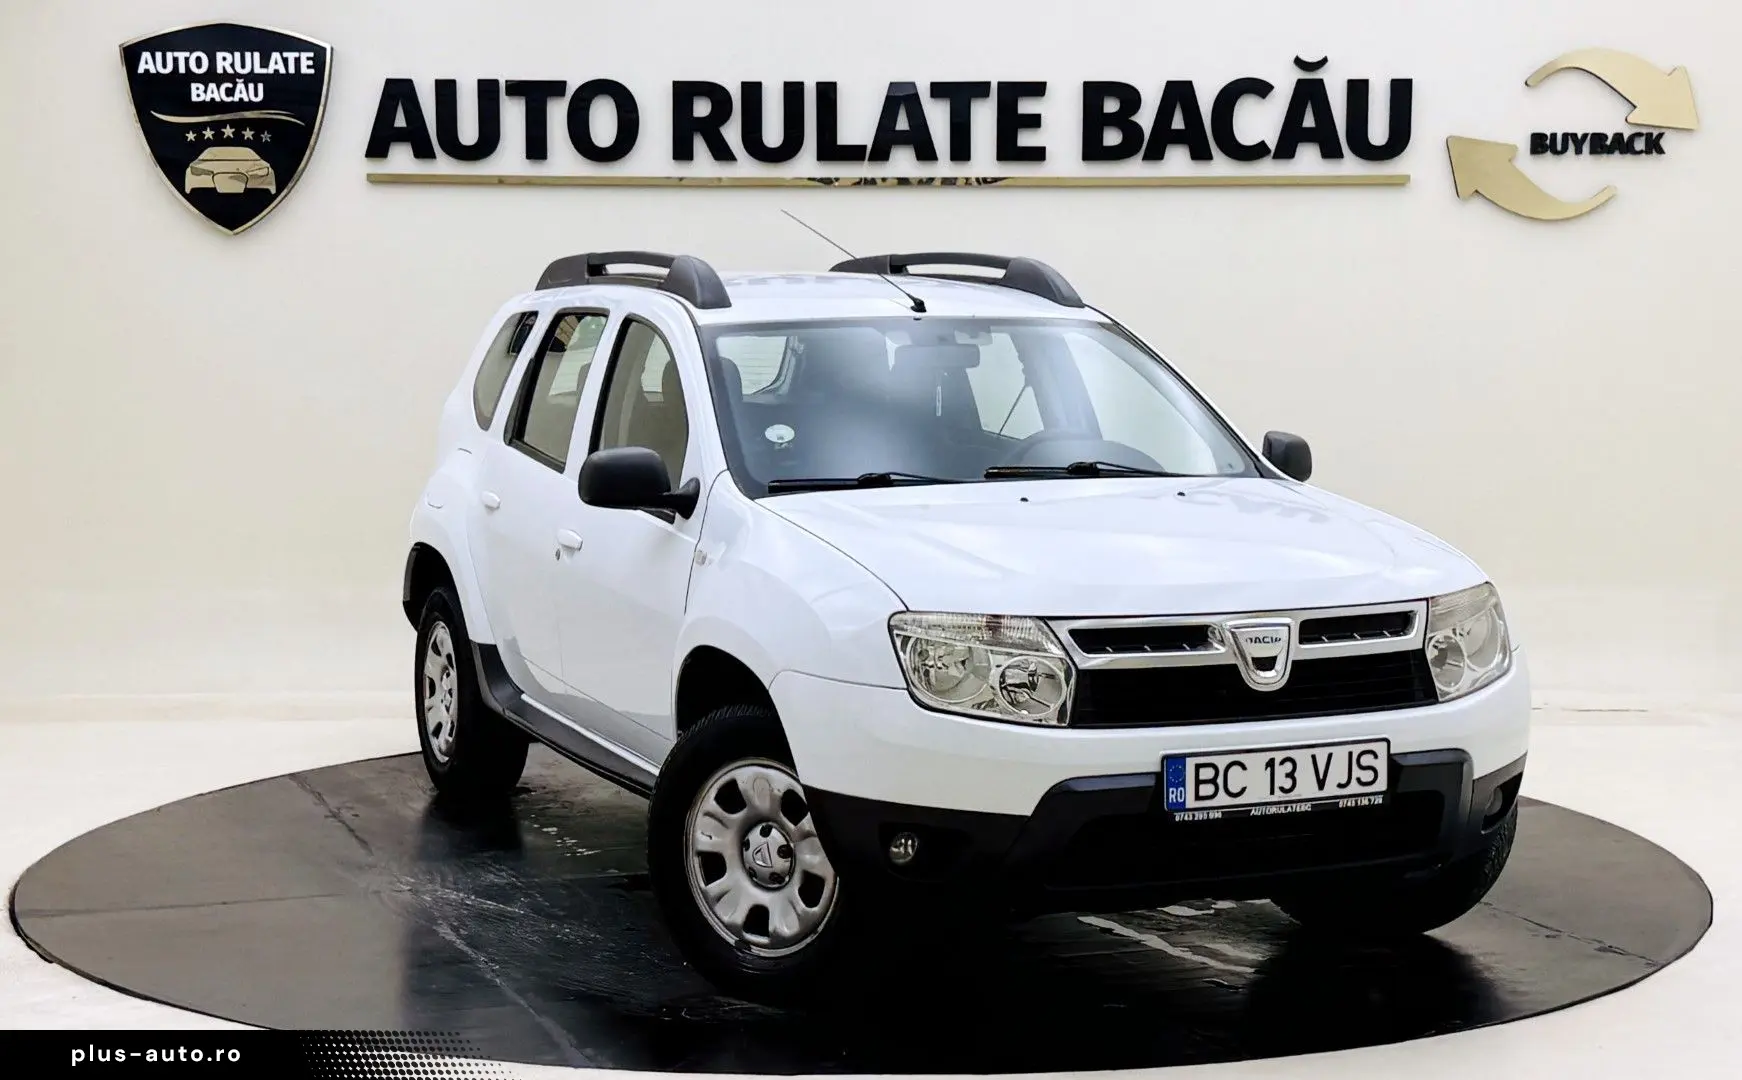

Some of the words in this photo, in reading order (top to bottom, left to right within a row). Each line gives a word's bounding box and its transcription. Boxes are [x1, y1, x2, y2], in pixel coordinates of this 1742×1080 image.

[137, 51, 209, 75] AUTO
[215, 51, 315, 75] RULATE
[190, 79, 264, 103] BACĂU
[365, 78, 640, 162] AUTO
[672, 80, 1048, 163] RULATE
[1081, 55, 1413, 161] BACĂU
[1529, 132, 1666, 156] BUYBACK
[1193, 760, 1248, 802] BC
[1264, 756, 1298, 796] 13
[1310, 750, 1380, 792] VJS
[1168, 787, 1185, 803] RO
